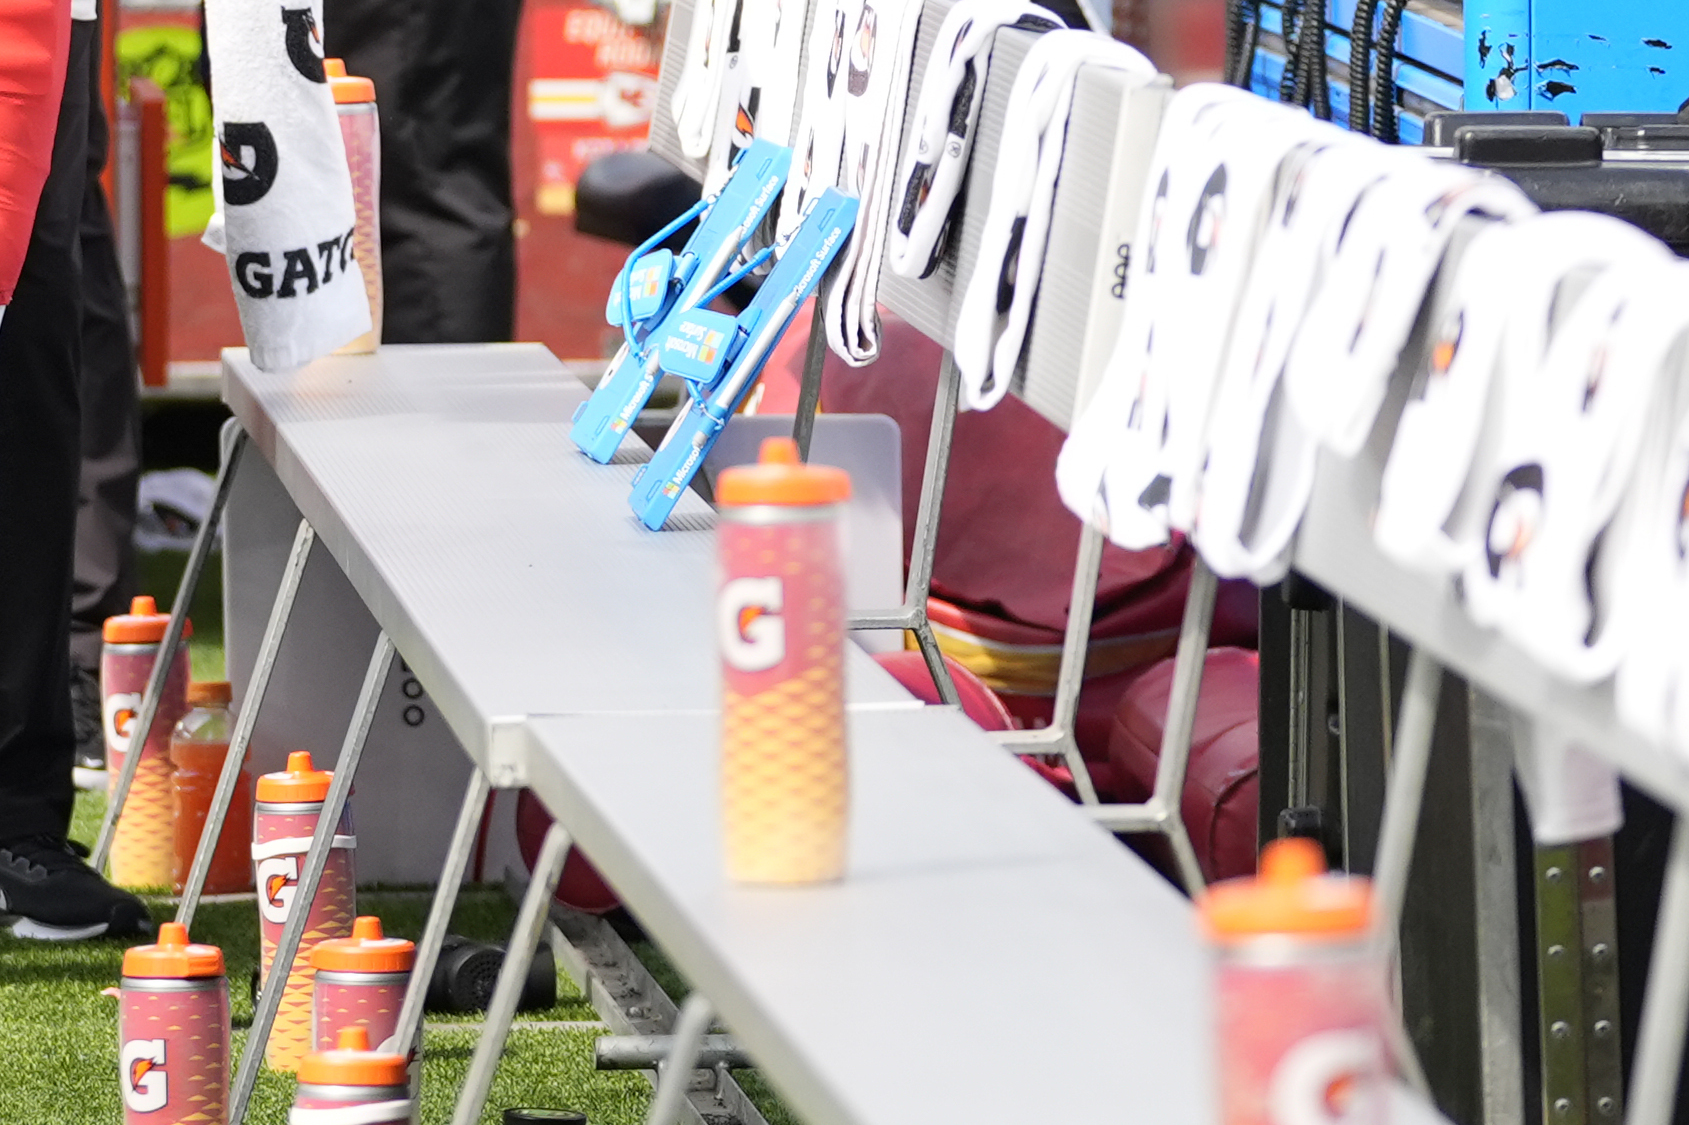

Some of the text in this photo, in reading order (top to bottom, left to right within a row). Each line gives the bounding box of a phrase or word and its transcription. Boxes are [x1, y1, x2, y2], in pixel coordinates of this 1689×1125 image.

[755, 175, 780, 209] Surface
[816, 226, 843, 261] Surface
[619, 379, 650, 422] Microsoft
[673, 444, 701, 485] Microsof
[716, 575, 785, 674] G
[258, 856, 299, 924] G
[122, 1038, 168, 1113] G
